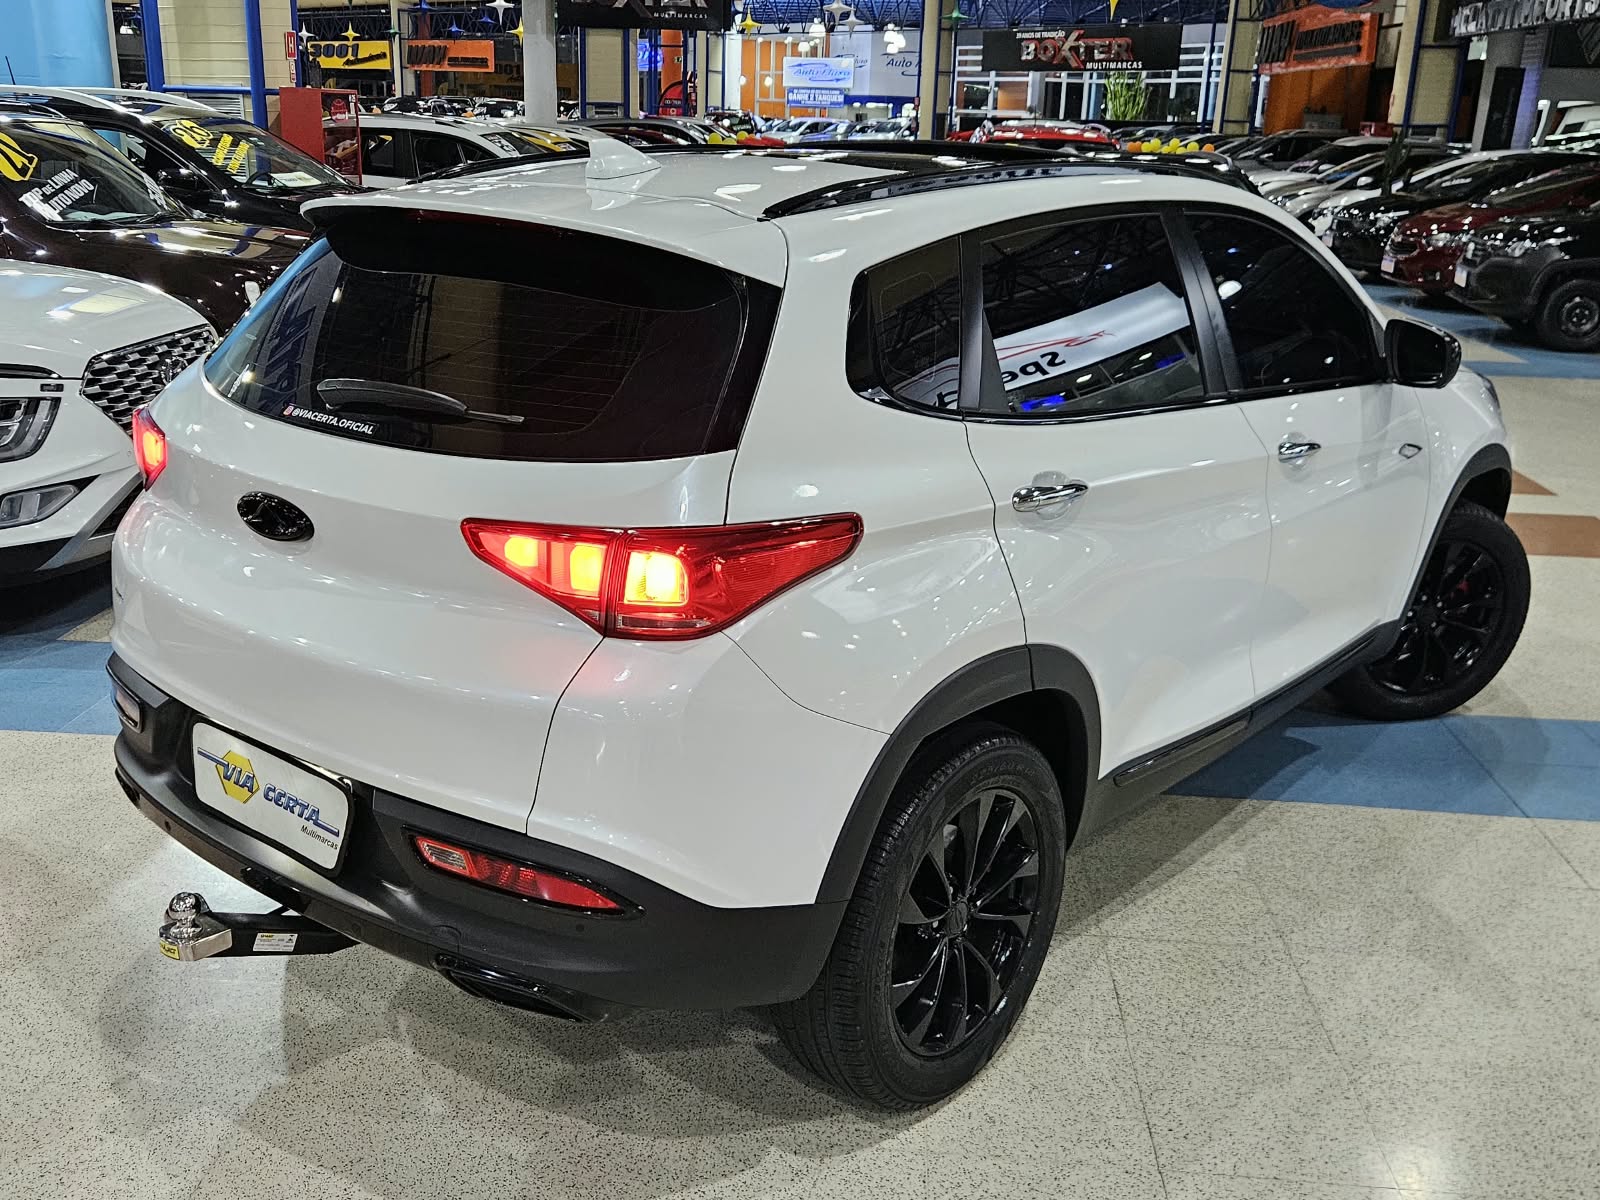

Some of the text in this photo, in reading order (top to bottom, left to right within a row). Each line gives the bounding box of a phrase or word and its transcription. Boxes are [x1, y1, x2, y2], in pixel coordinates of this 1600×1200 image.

[288, 36, 294, 53] H
[309, 43, 359, 58] 3001
[1020, 30, 1134, 68] BOXTER
[793, 66, 819, 76] Auto
[886, 57, 912, 68] Auto
[1086, 62, 1143, 70] MULTIMARCAS
[18, 168, 79, 208] TOP DE LINHA
[63, 178, 95, 201] NOVO
[291, 407, 374, 435] @VIACERTA.OFICIAL
[222, 763, 320, 823] VIA CERTA
[301, 824, 338, 850] Multimarcas
